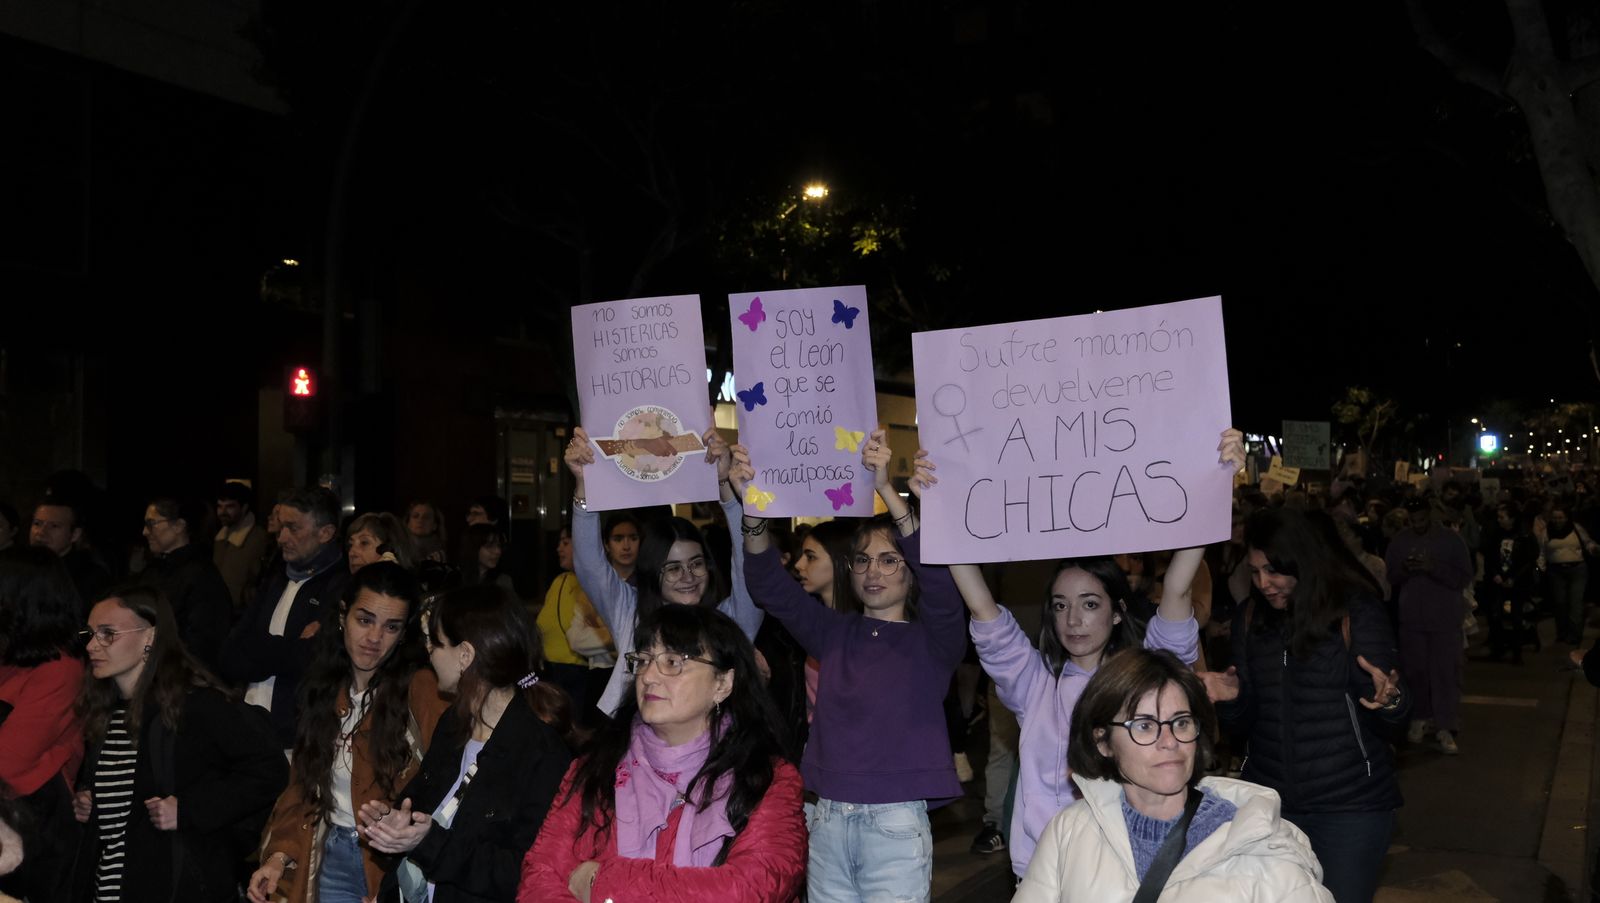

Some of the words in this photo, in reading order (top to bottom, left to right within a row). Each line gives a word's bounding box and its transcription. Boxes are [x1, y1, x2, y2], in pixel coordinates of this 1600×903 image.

[592, 307, 615, 322] no
[632, 303, 673, 319] somos
[593, 321, 678, 347] HISTERICAS
[1074, 319, 1194, 358] mamón
[613, 346, 658, 363] somos
[770, 341, 790, 369] el
[799, 338, 844, 368] león
[774, 376, 809, 408] que
[815, 375, 835, 393] se
[992, 367, 1175, 410] devuelveme
[776, 405, 832, 429] comió
[786, 430, 819, 457] las
[998, 418, 1034, 465] A
[1055, 407, 1136, 460] MIS
[761, 464, 854, 493] mariposas
[964, 461, 1188, 540] CHICAS
